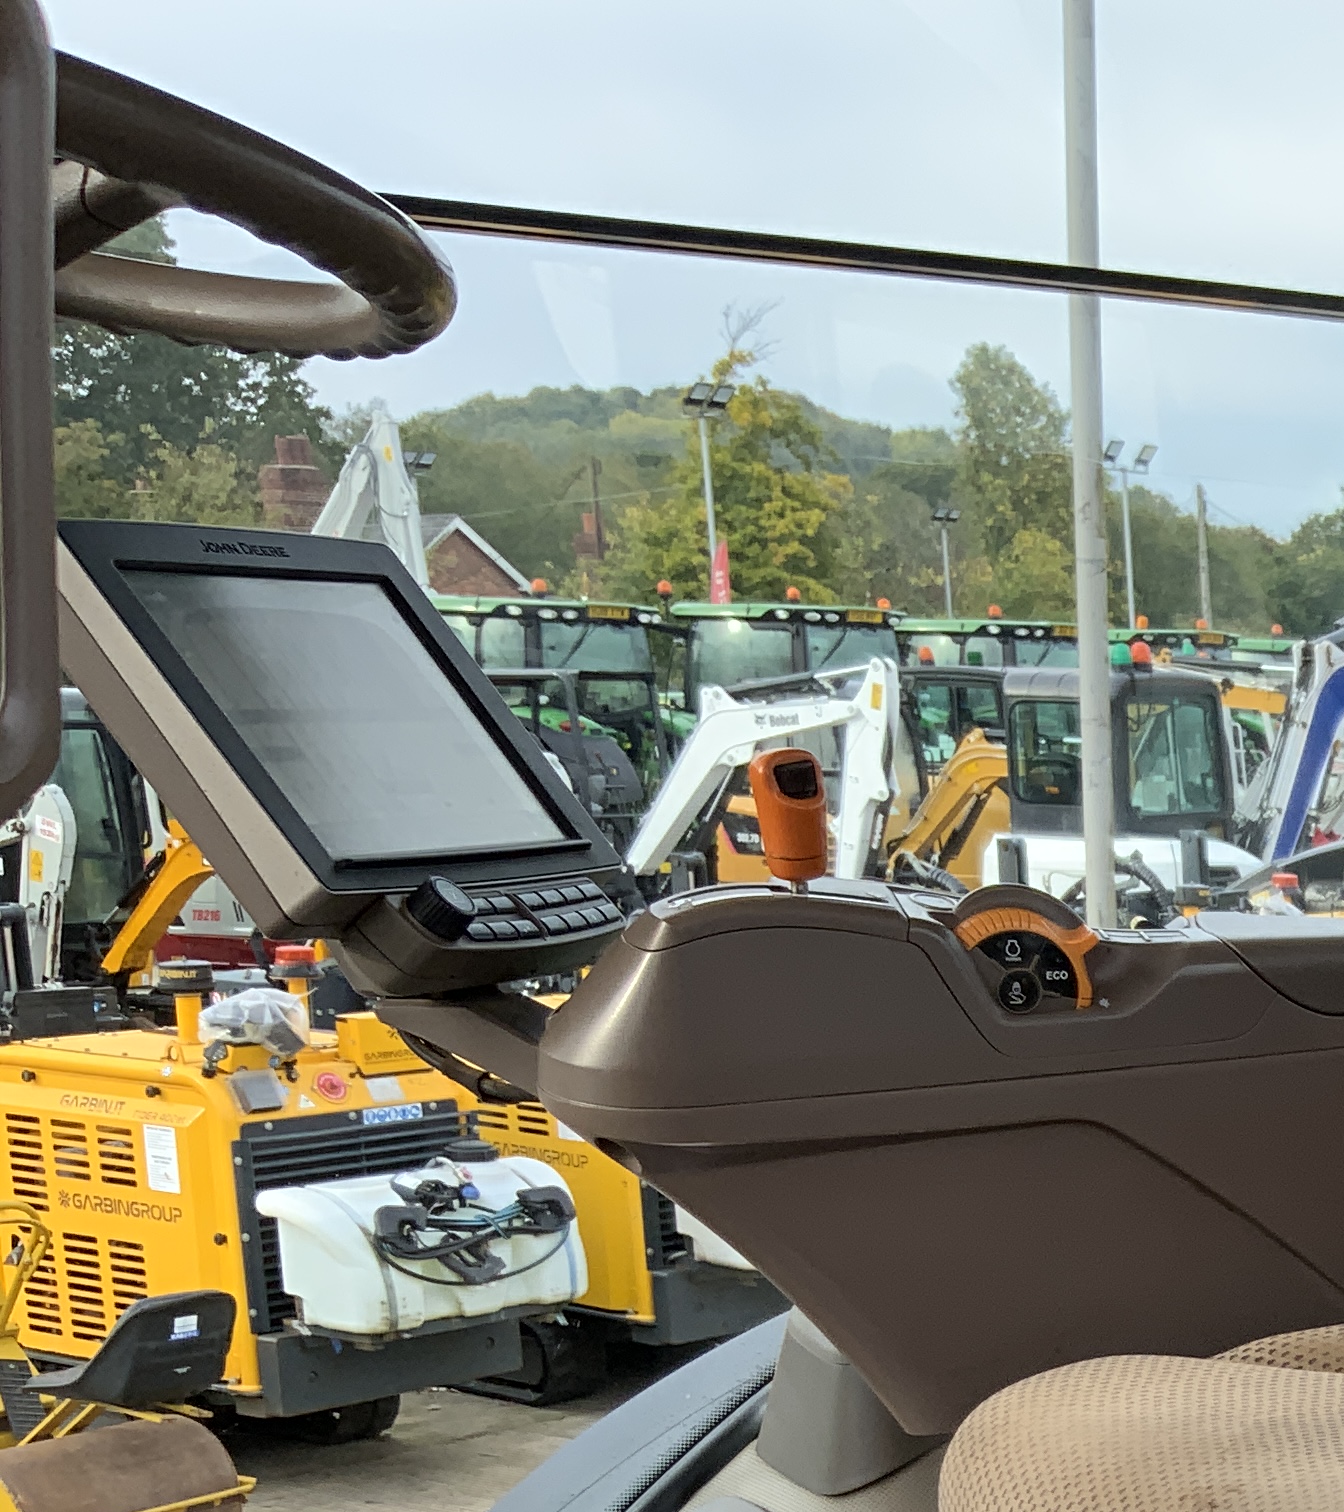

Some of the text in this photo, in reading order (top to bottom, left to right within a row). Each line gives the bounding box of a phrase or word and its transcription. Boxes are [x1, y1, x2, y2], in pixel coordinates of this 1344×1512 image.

[199, 539, 290, 557] JOHN DEERE
[769, 713, 800, 727] Bobcat
[192, 909, 221, 922] TB216
[1046, 970, 1069, 981] ECO
[72, 1193, 183, 1223] GARBINGROUP
